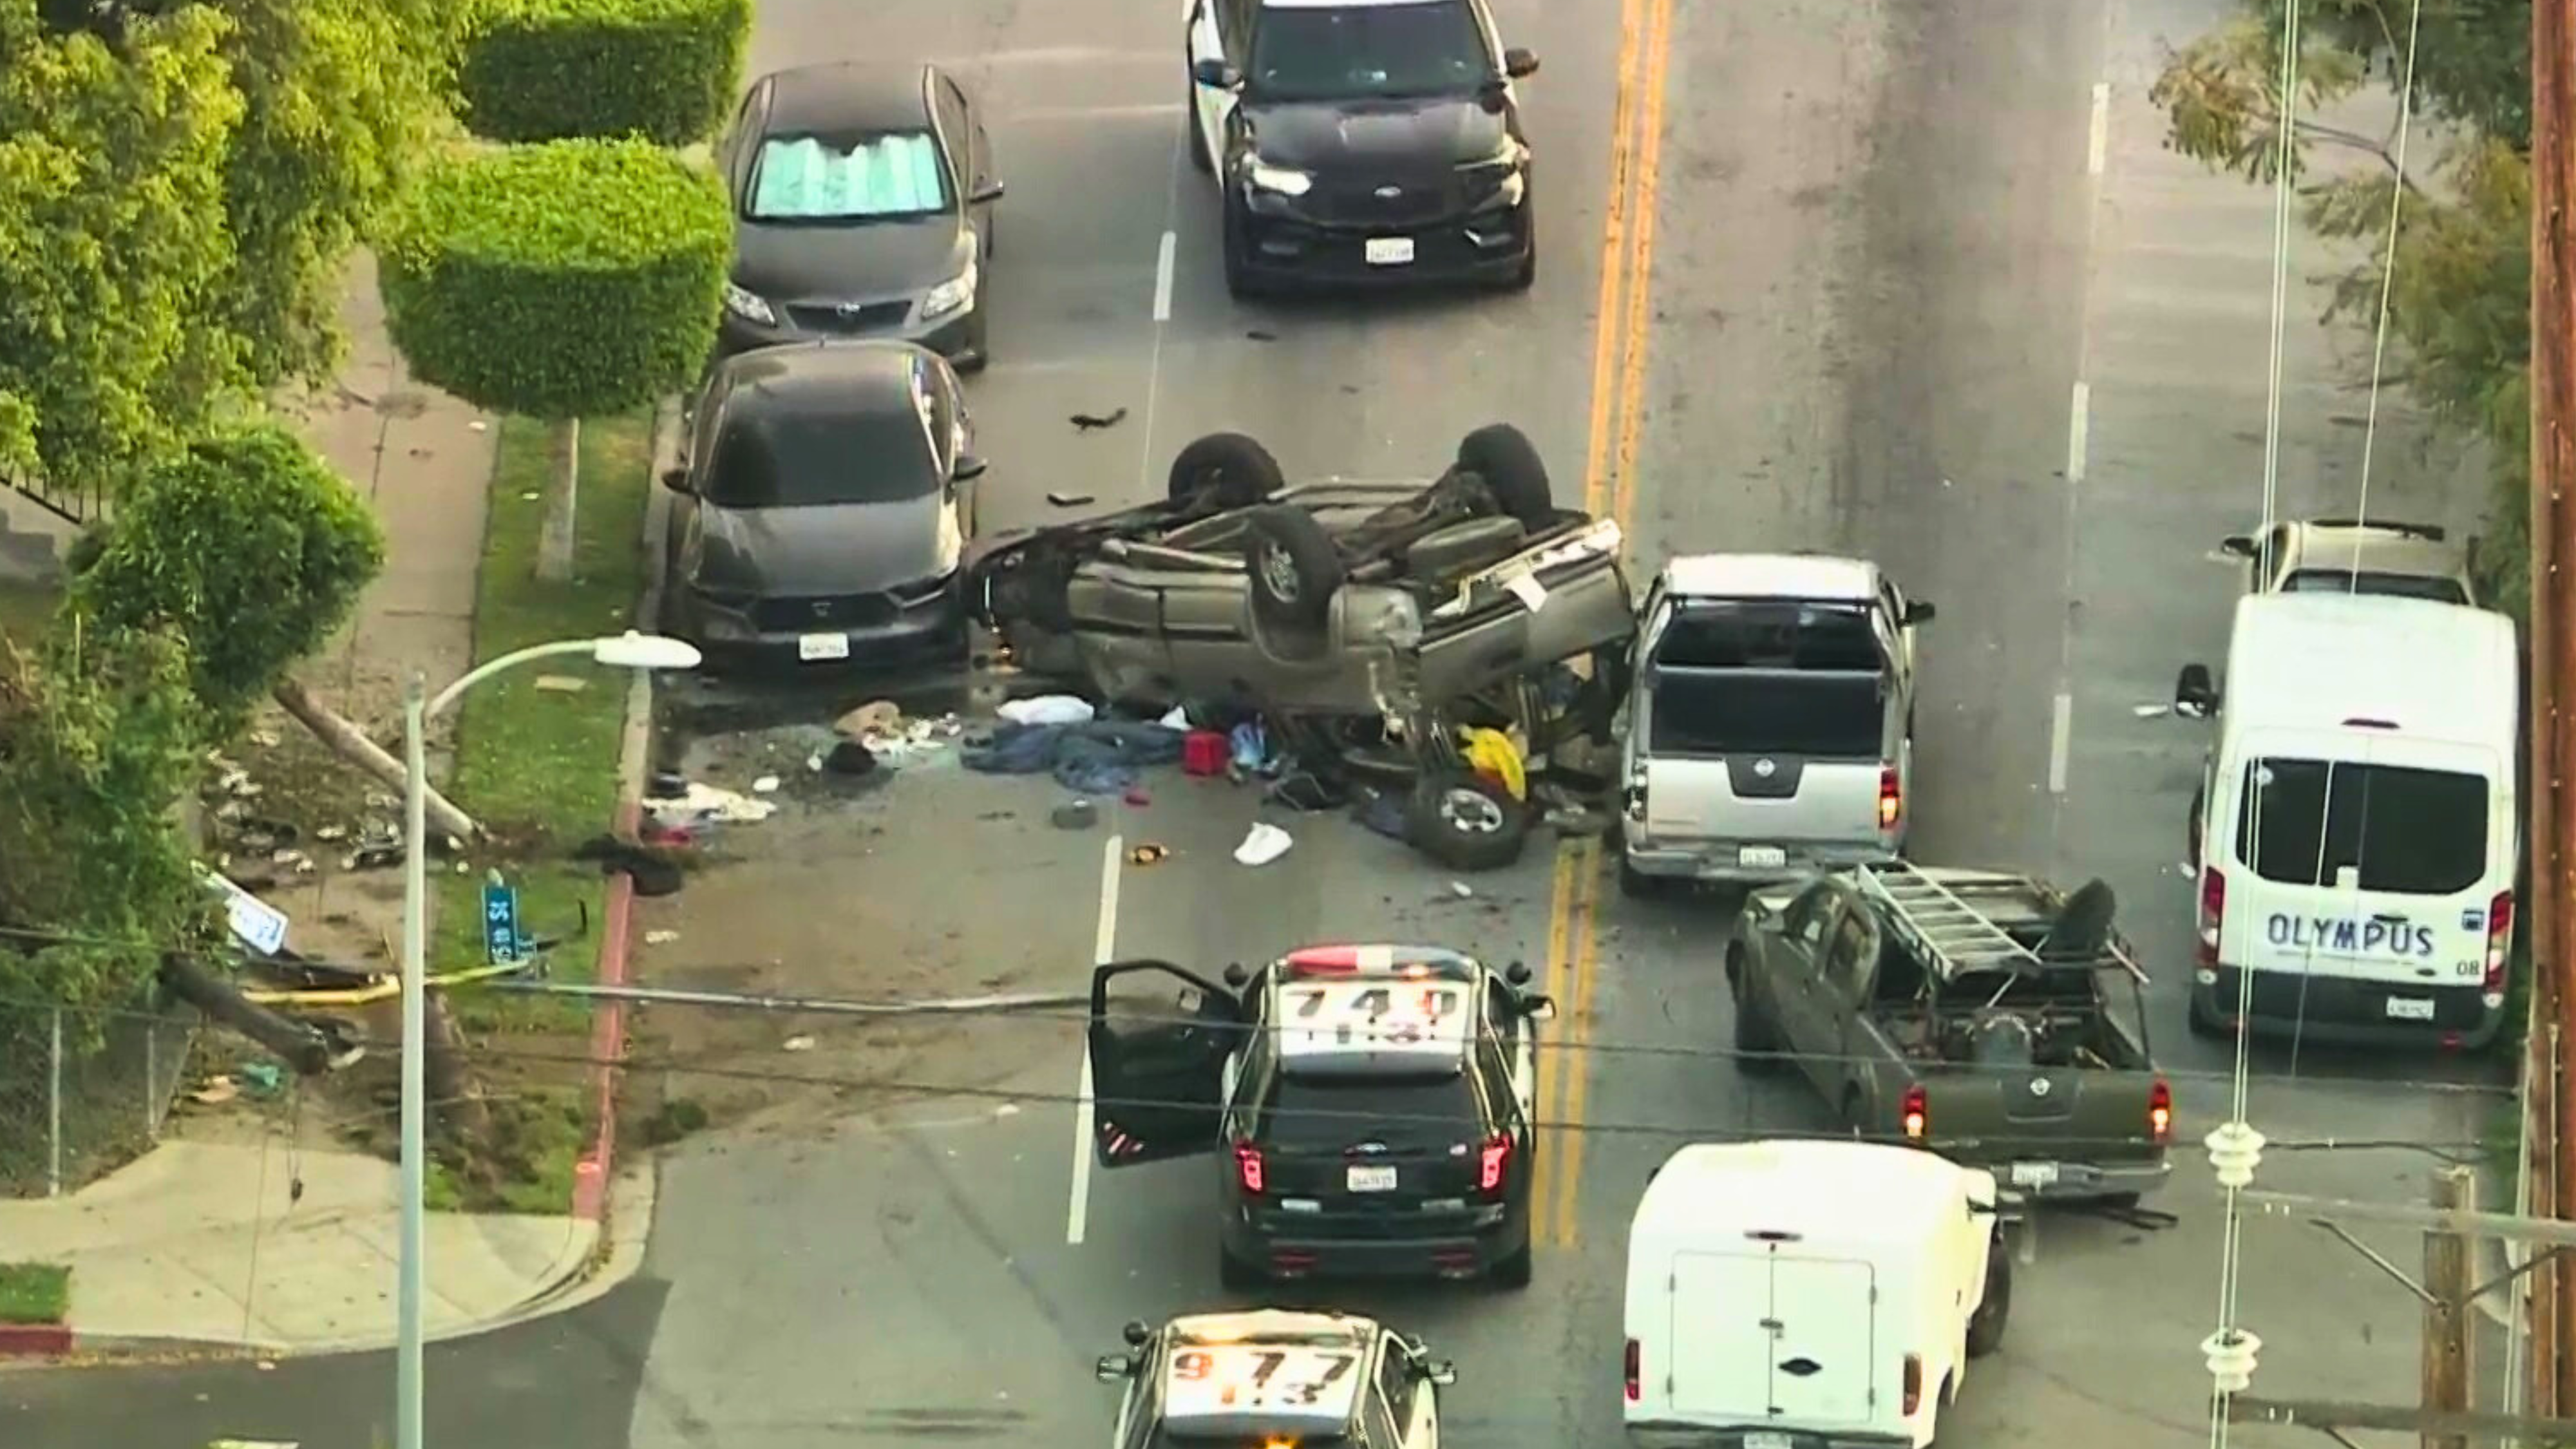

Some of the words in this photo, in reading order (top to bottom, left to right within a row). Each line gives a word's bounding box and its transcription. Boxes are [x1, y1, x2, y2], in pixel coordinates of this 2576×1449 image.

[2268, 913, 2434, 956] OLYMPUS
[2456, 960, 2480, 976] 08
[1174, 1352, 1355, 1382] 977
